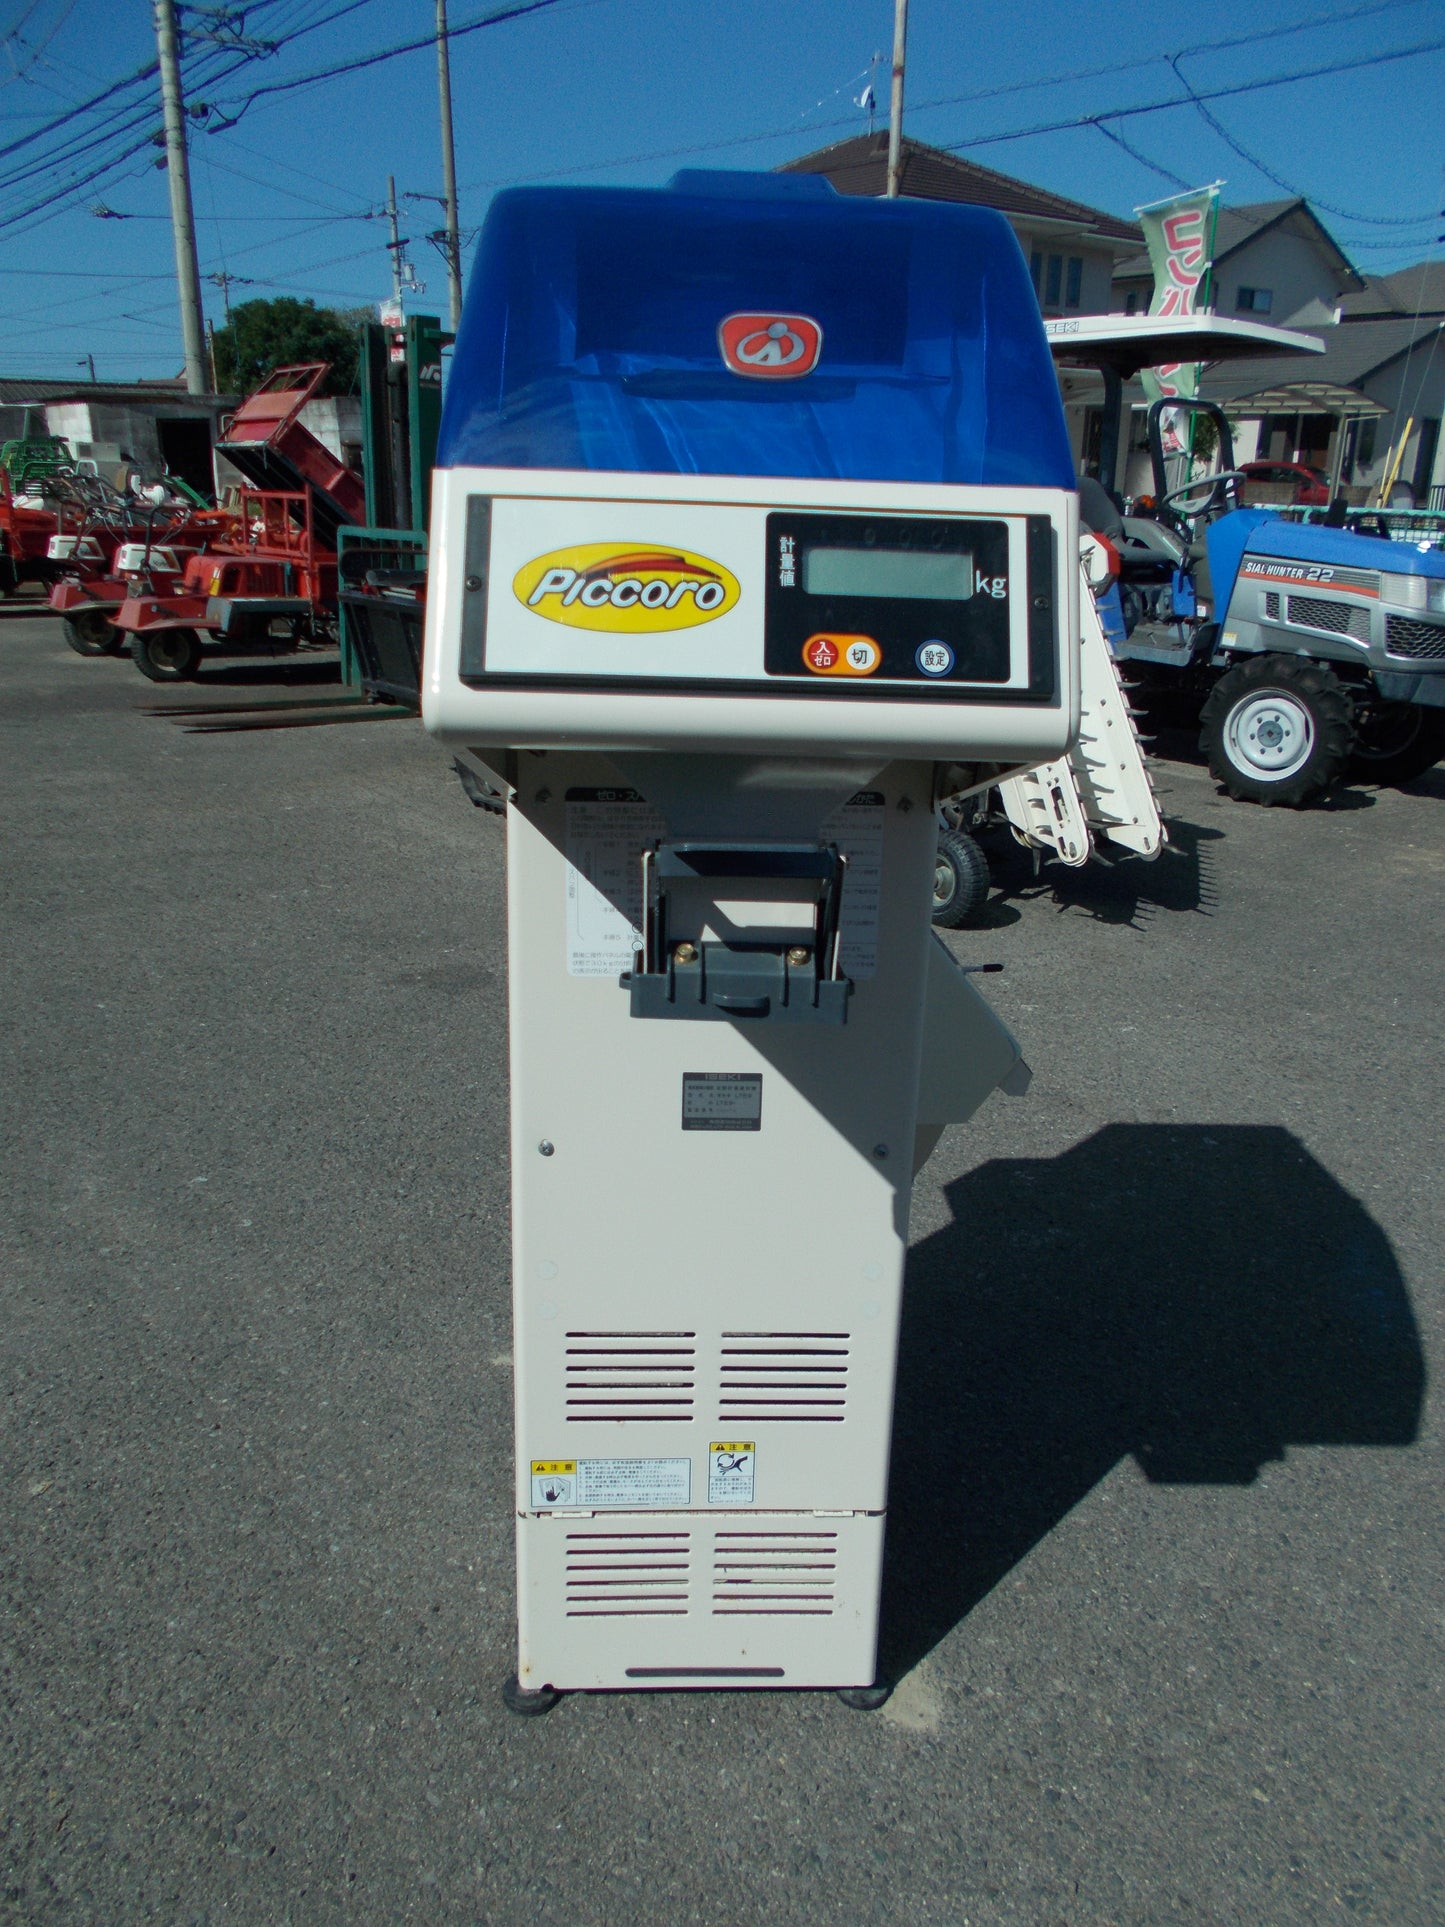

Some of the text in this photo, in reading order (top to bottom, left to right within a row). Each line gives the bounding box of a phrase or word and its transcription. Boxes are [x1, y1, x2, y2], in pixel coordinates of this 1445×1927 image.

[1045, 320, 1080, 333] SEKI
[779, 536, 796, 587] 計量値
[1245, 562, 1334, 583] SIAL HUNTER 22
[527, 567, 725, 611] Piccoro
[975, 570, 1007, 598] kg
[816, 641, 831, 654] 入
[814, 655, 831, 667] ゼロ
[851, 649, 868, 664] 切
[924, 650, 946, 667] 設定
[549, 1463, 573, 1472] 注意
